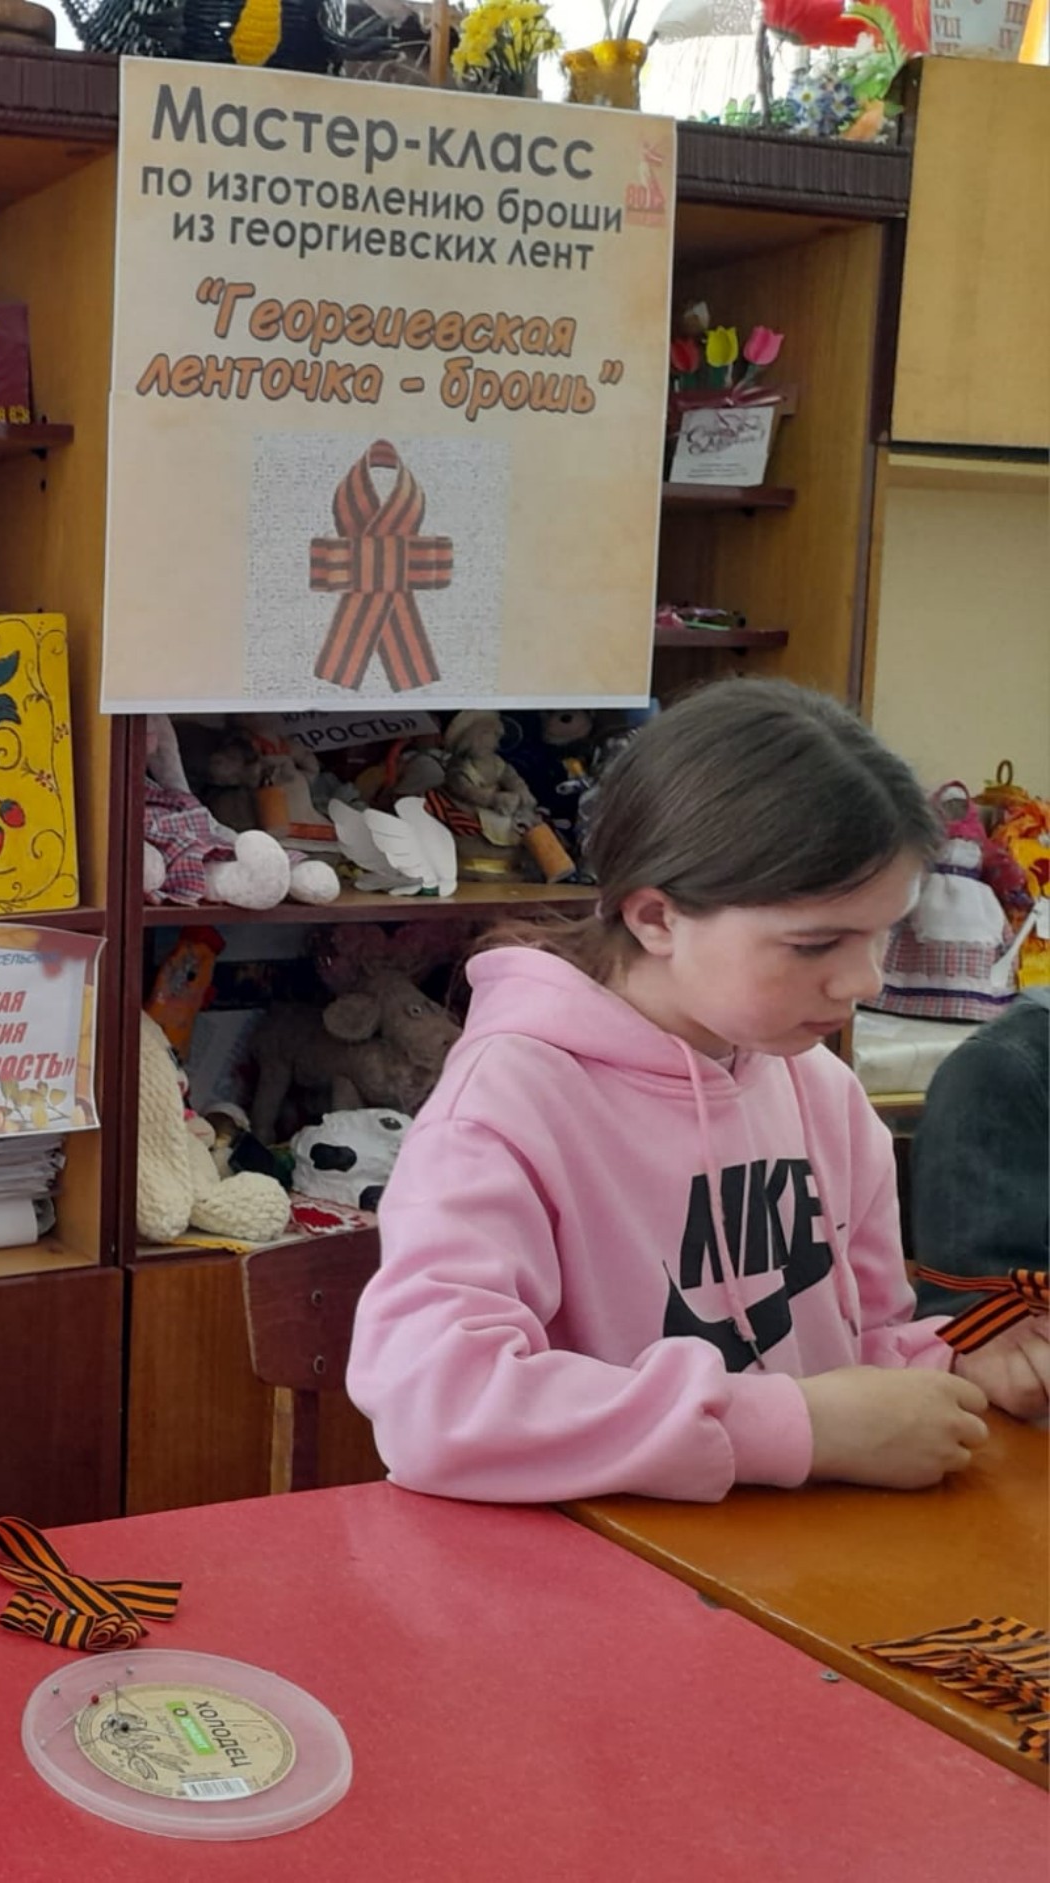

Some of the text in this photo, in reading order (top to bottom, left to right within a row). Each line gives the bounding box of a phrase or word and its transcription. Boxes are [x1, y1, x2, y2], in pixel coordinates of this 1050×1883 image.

[151, 83, 594, 180] Мастер-класс
[141, 166, 623, 234] по изготовлению броши
[173, 212, 594, 270] из георгиевских лент
[136, 352, 384, 404] ленточка
[400, 376, 426, 393] -
[193, 1701, 252, 1768] ХОЛОДЕЦ
